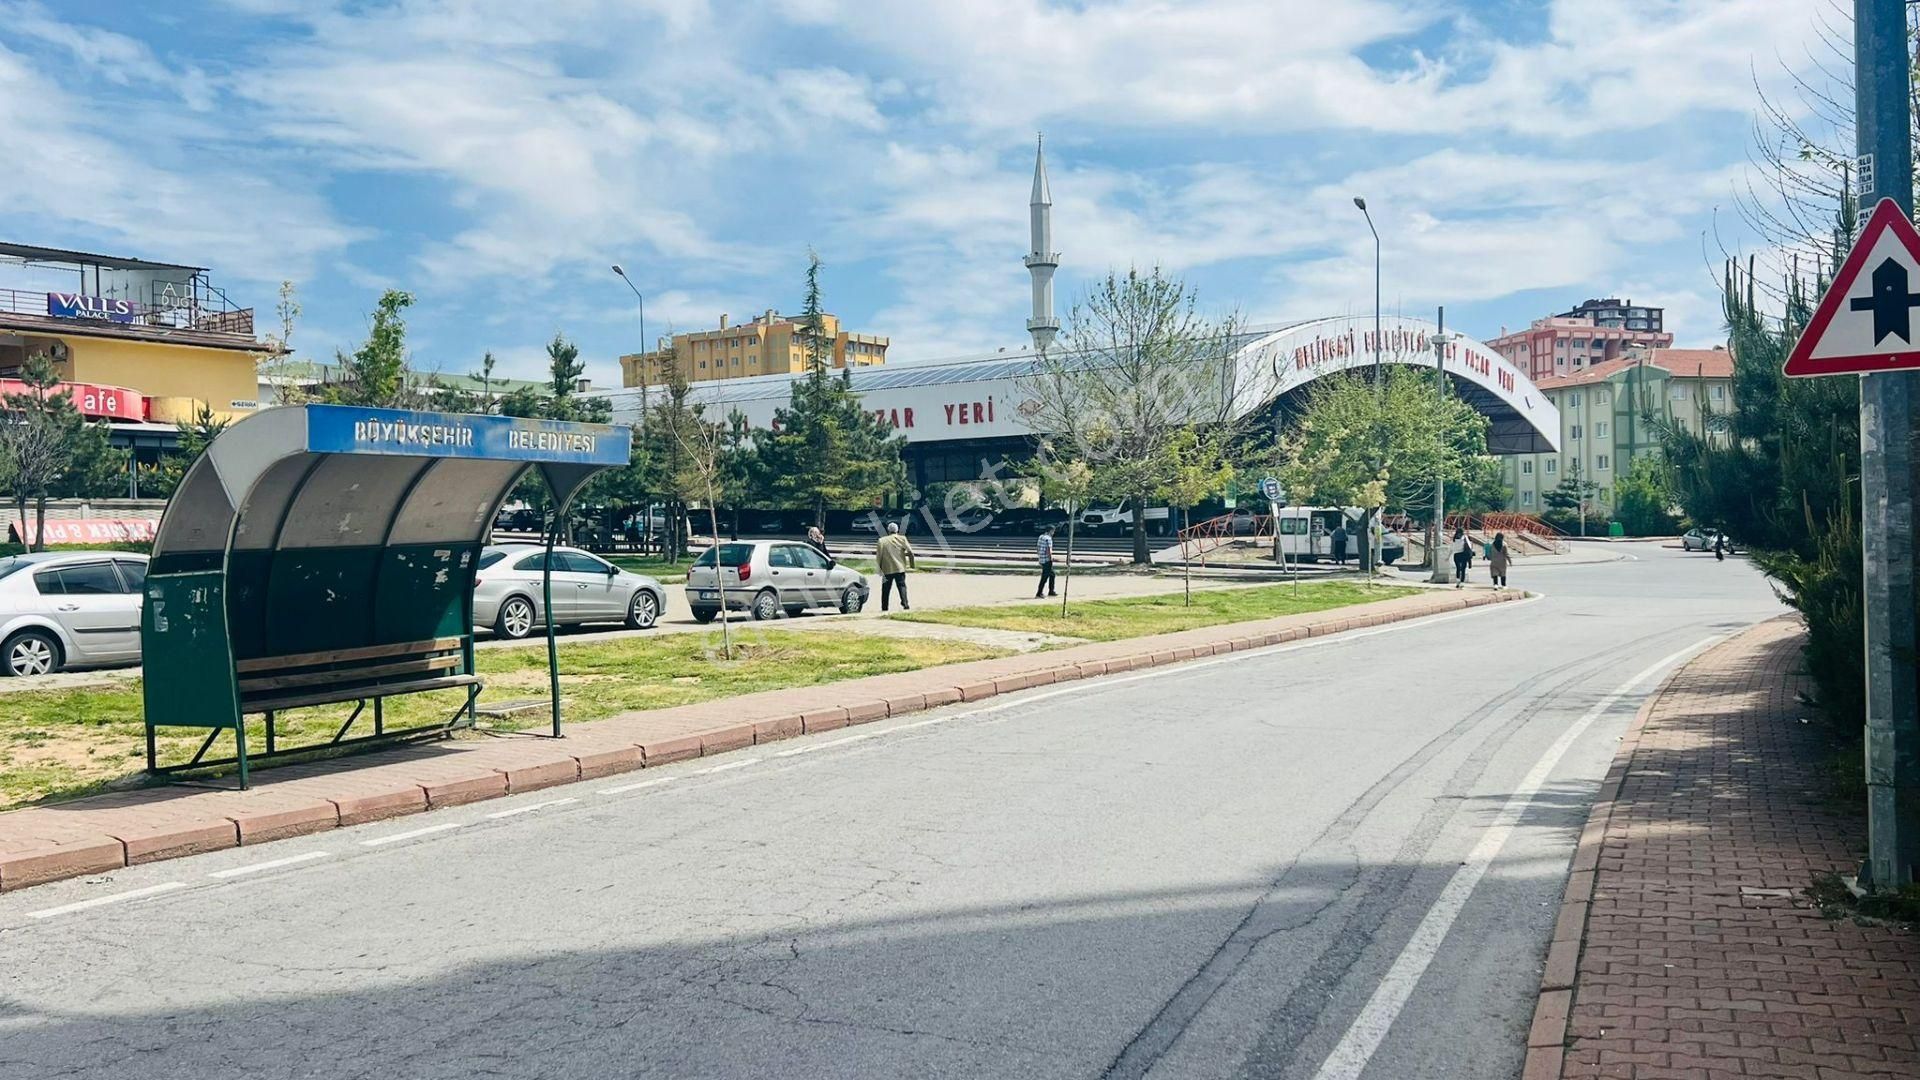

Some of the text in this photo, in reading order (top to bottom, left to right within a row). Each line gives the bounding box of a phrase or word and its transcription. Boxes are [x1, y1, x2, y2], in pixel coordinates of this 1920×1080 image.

[57, 293, 129, 314] VALLS
[76, 309, 110, 319] PALACE
[944, 396, 993, 425] YERİ
[354, 418, 596, 453] BÜYÜKŞEHİR BELEDİYESİ
